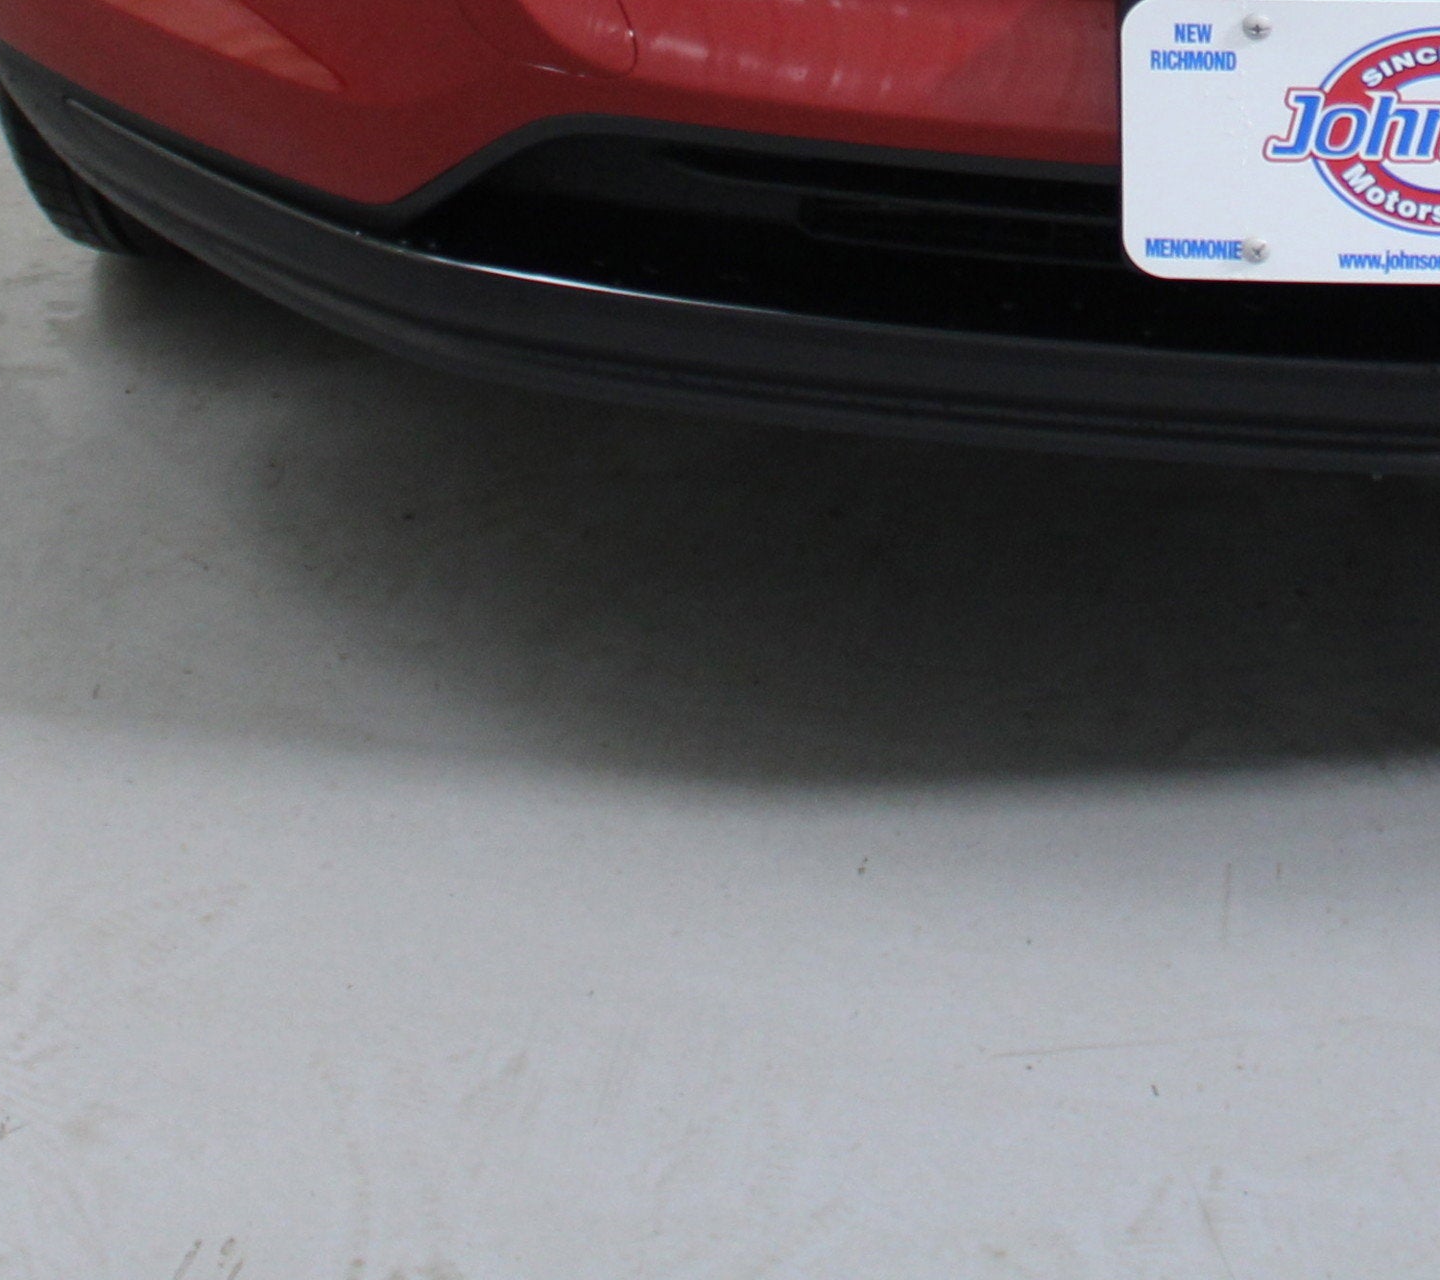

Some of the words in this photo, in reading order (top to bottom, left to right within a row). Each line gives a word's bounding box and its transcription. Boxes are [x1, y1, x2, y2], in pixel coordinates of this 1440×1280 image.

[1174, 23, 1212, 43] NEW
[1151, 50, 1237, 71] RICHMOND
[1145, 238, 1243, 260] MENOMONIE
